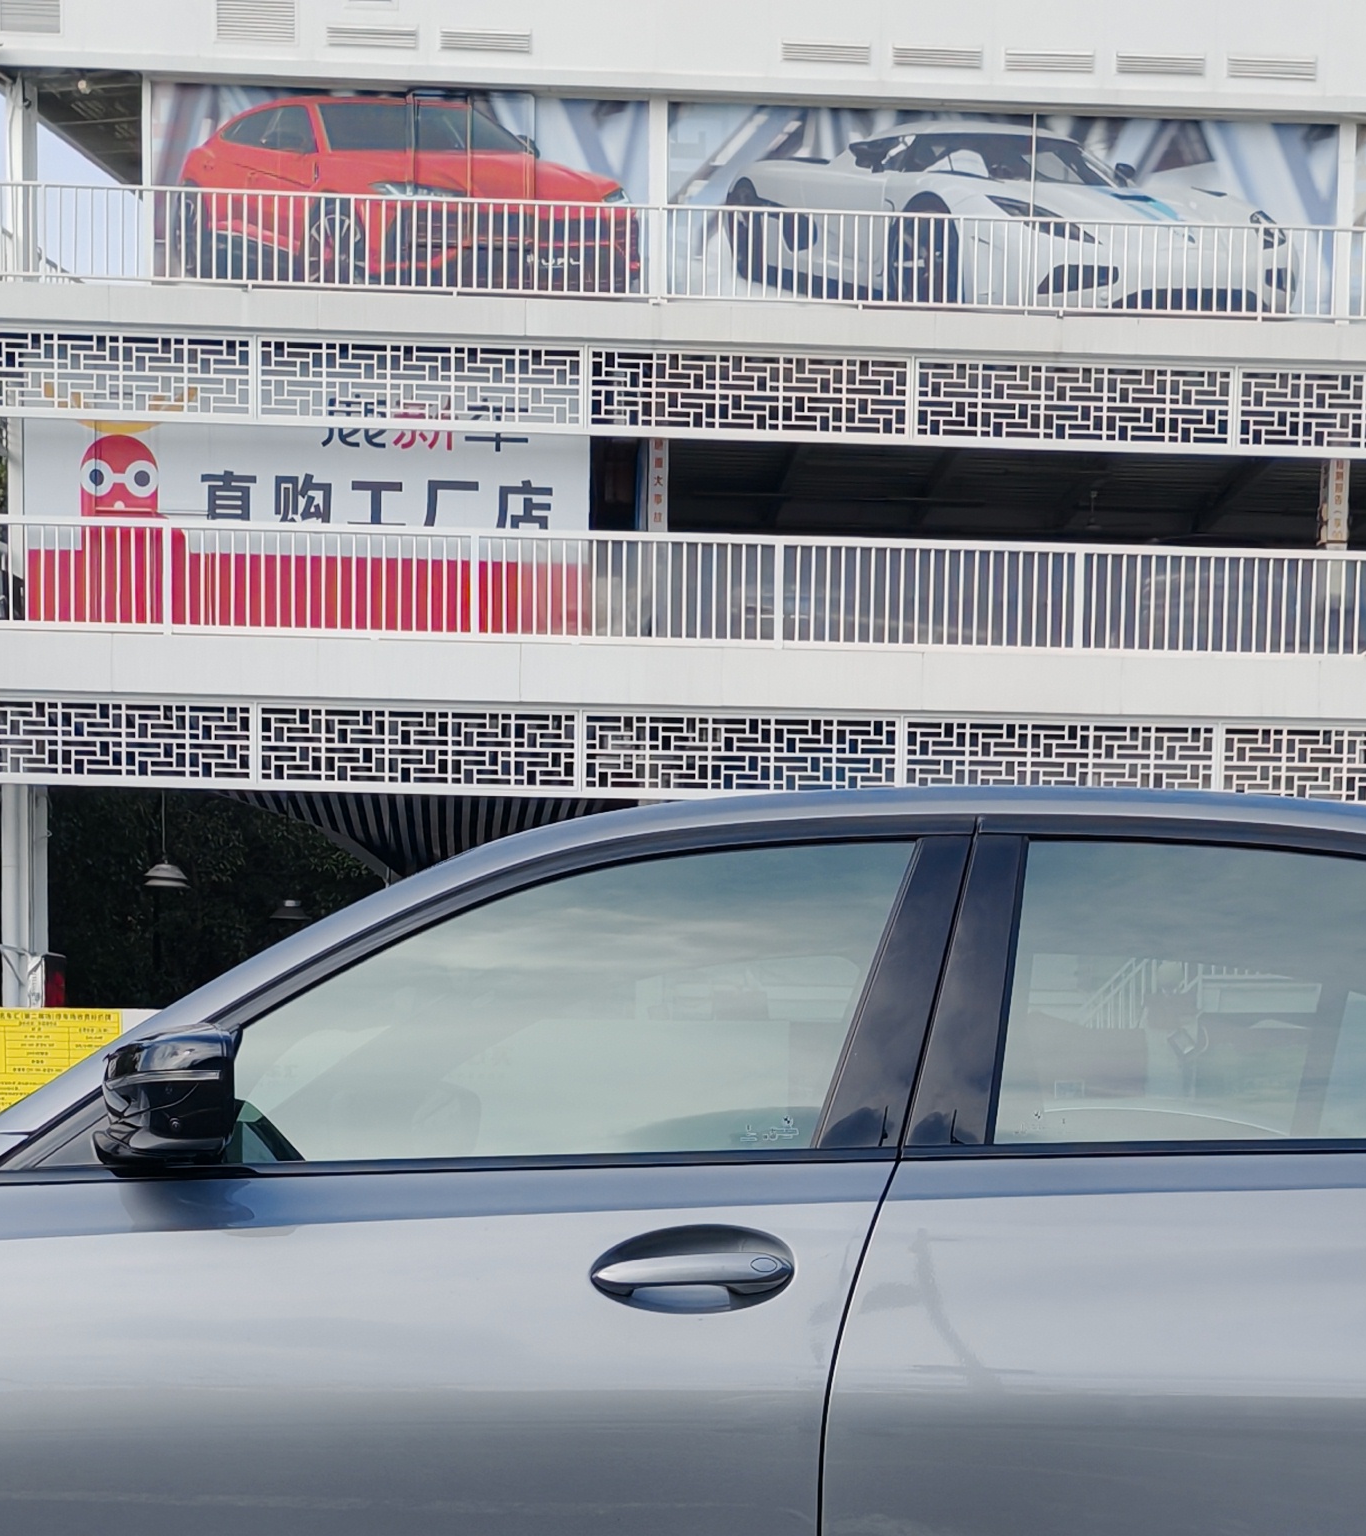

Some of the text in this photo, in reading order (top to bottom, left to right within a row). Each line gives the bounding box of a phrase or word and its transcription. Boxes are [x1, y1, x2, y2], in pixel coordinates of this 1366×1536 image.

[200, 470, 555, 530] 直购工厂店
